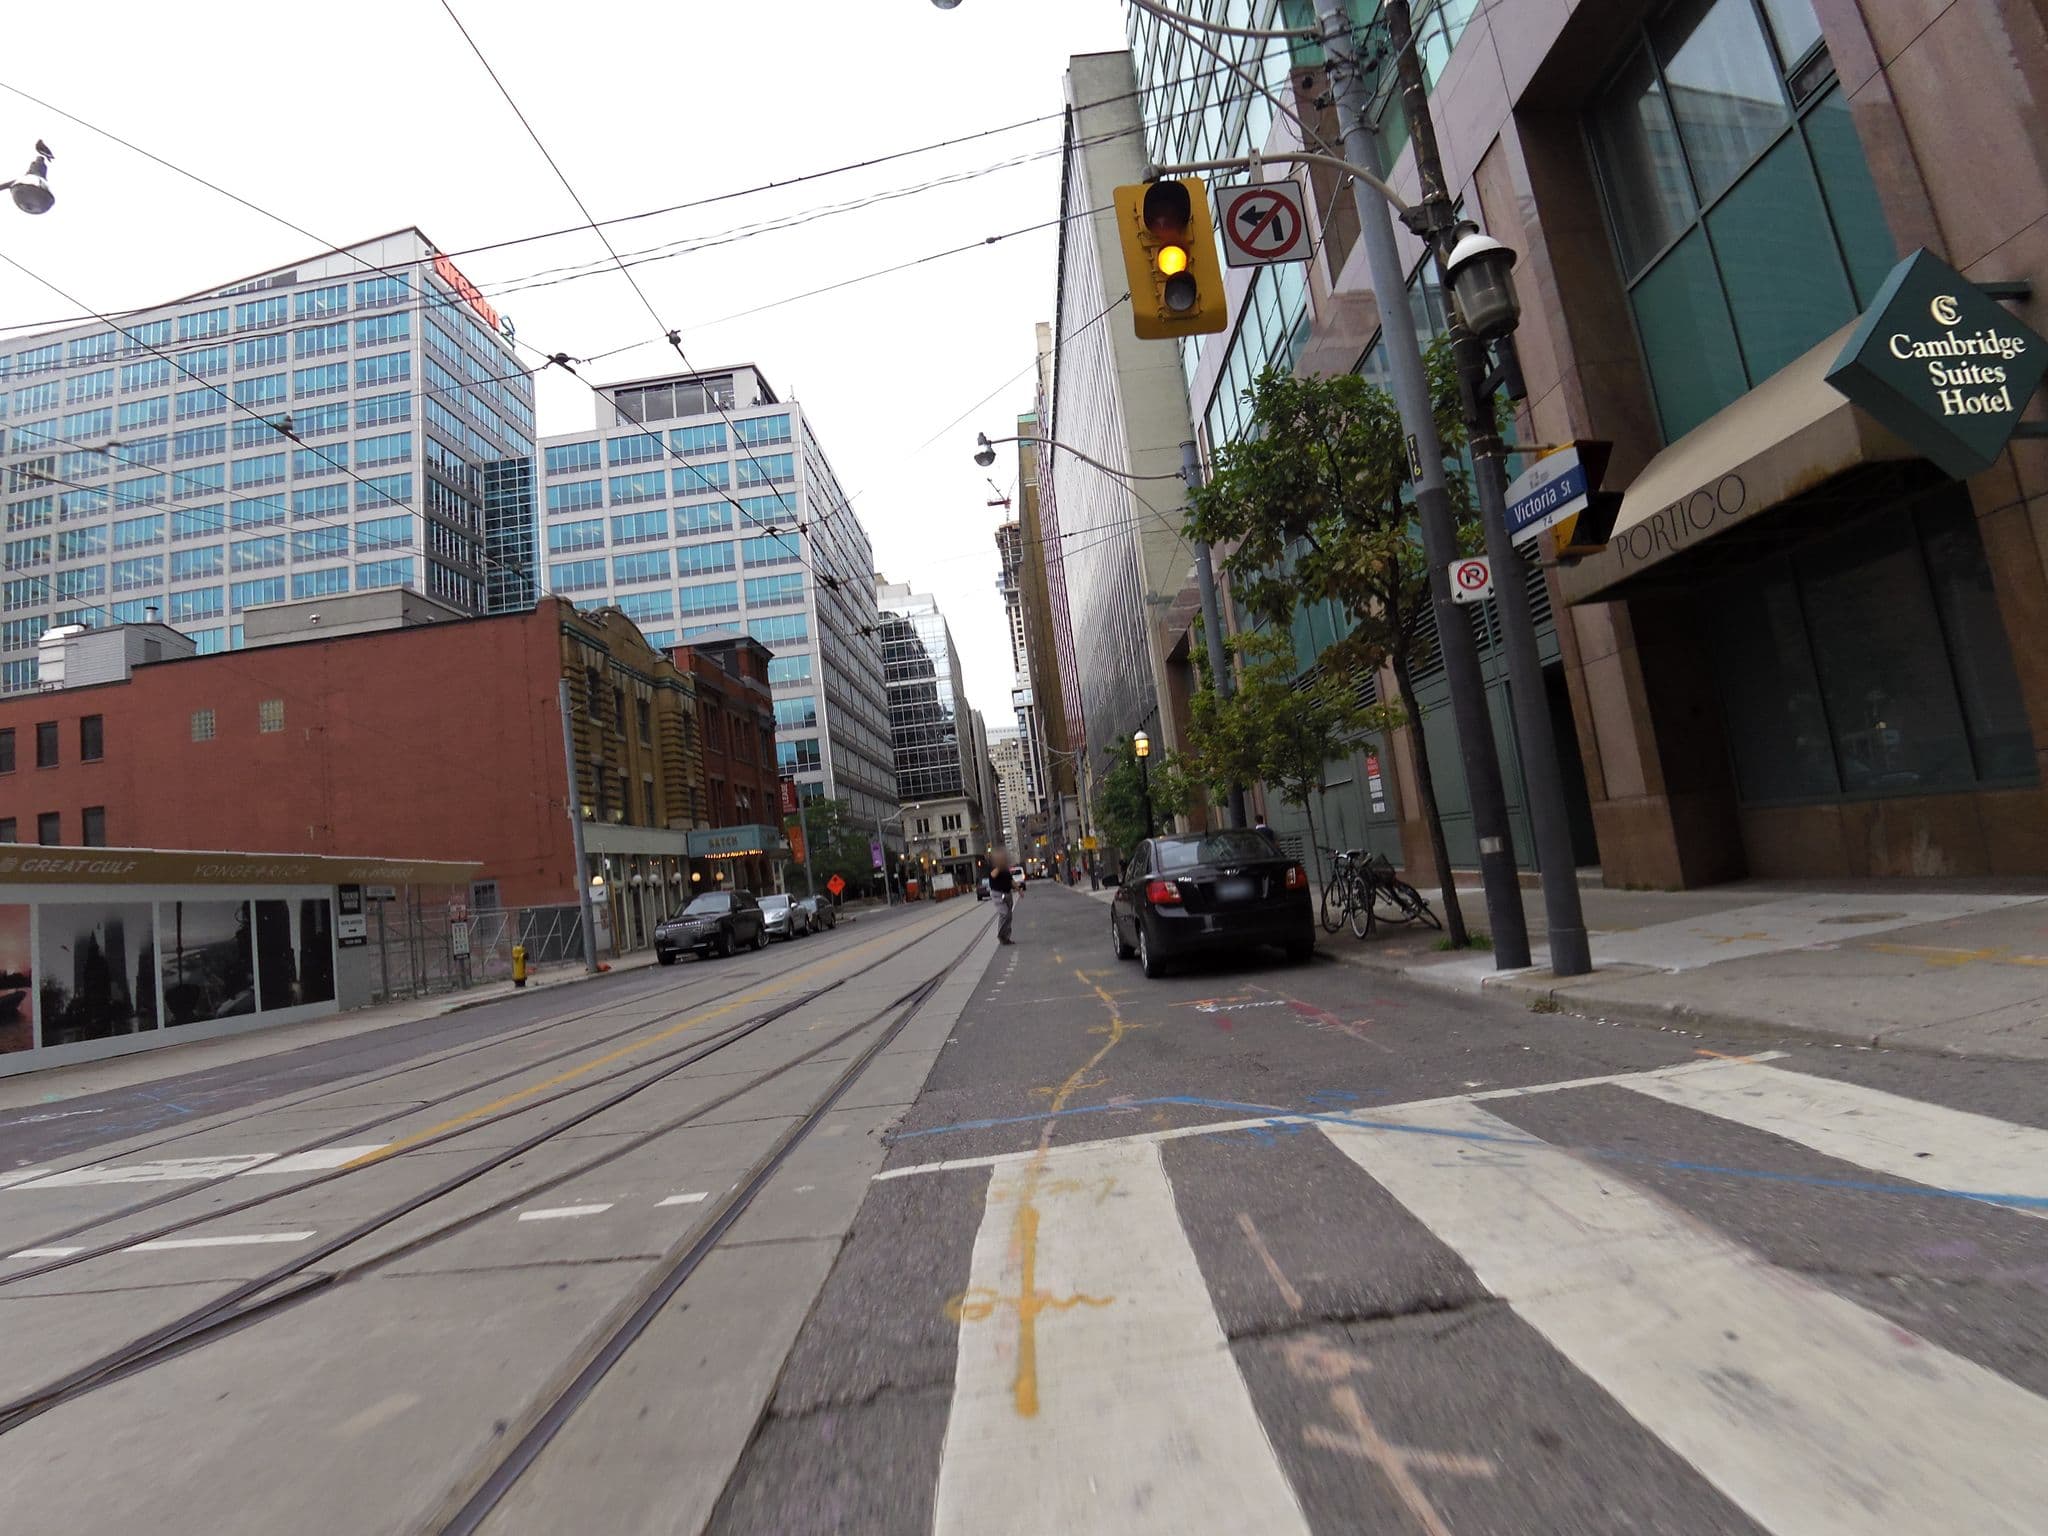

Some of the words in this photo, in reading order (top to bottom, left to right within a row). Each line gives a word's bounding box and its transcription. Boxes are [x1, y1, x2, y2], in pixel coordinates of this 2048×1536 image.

[1889, 328, 2026, 359] Cambridge
[1928, 360, 2007, 386] Suites
[1937, 385, 2014, 416] Hotel
[1514, 487, 1557, 523] Victoria
[1561, 480, 1572, 497] St
[1616, 474, 1746, 568] PORTICO
[21, 858, 89, 873] GREAT
[88, 860, 138, 873] GULF
